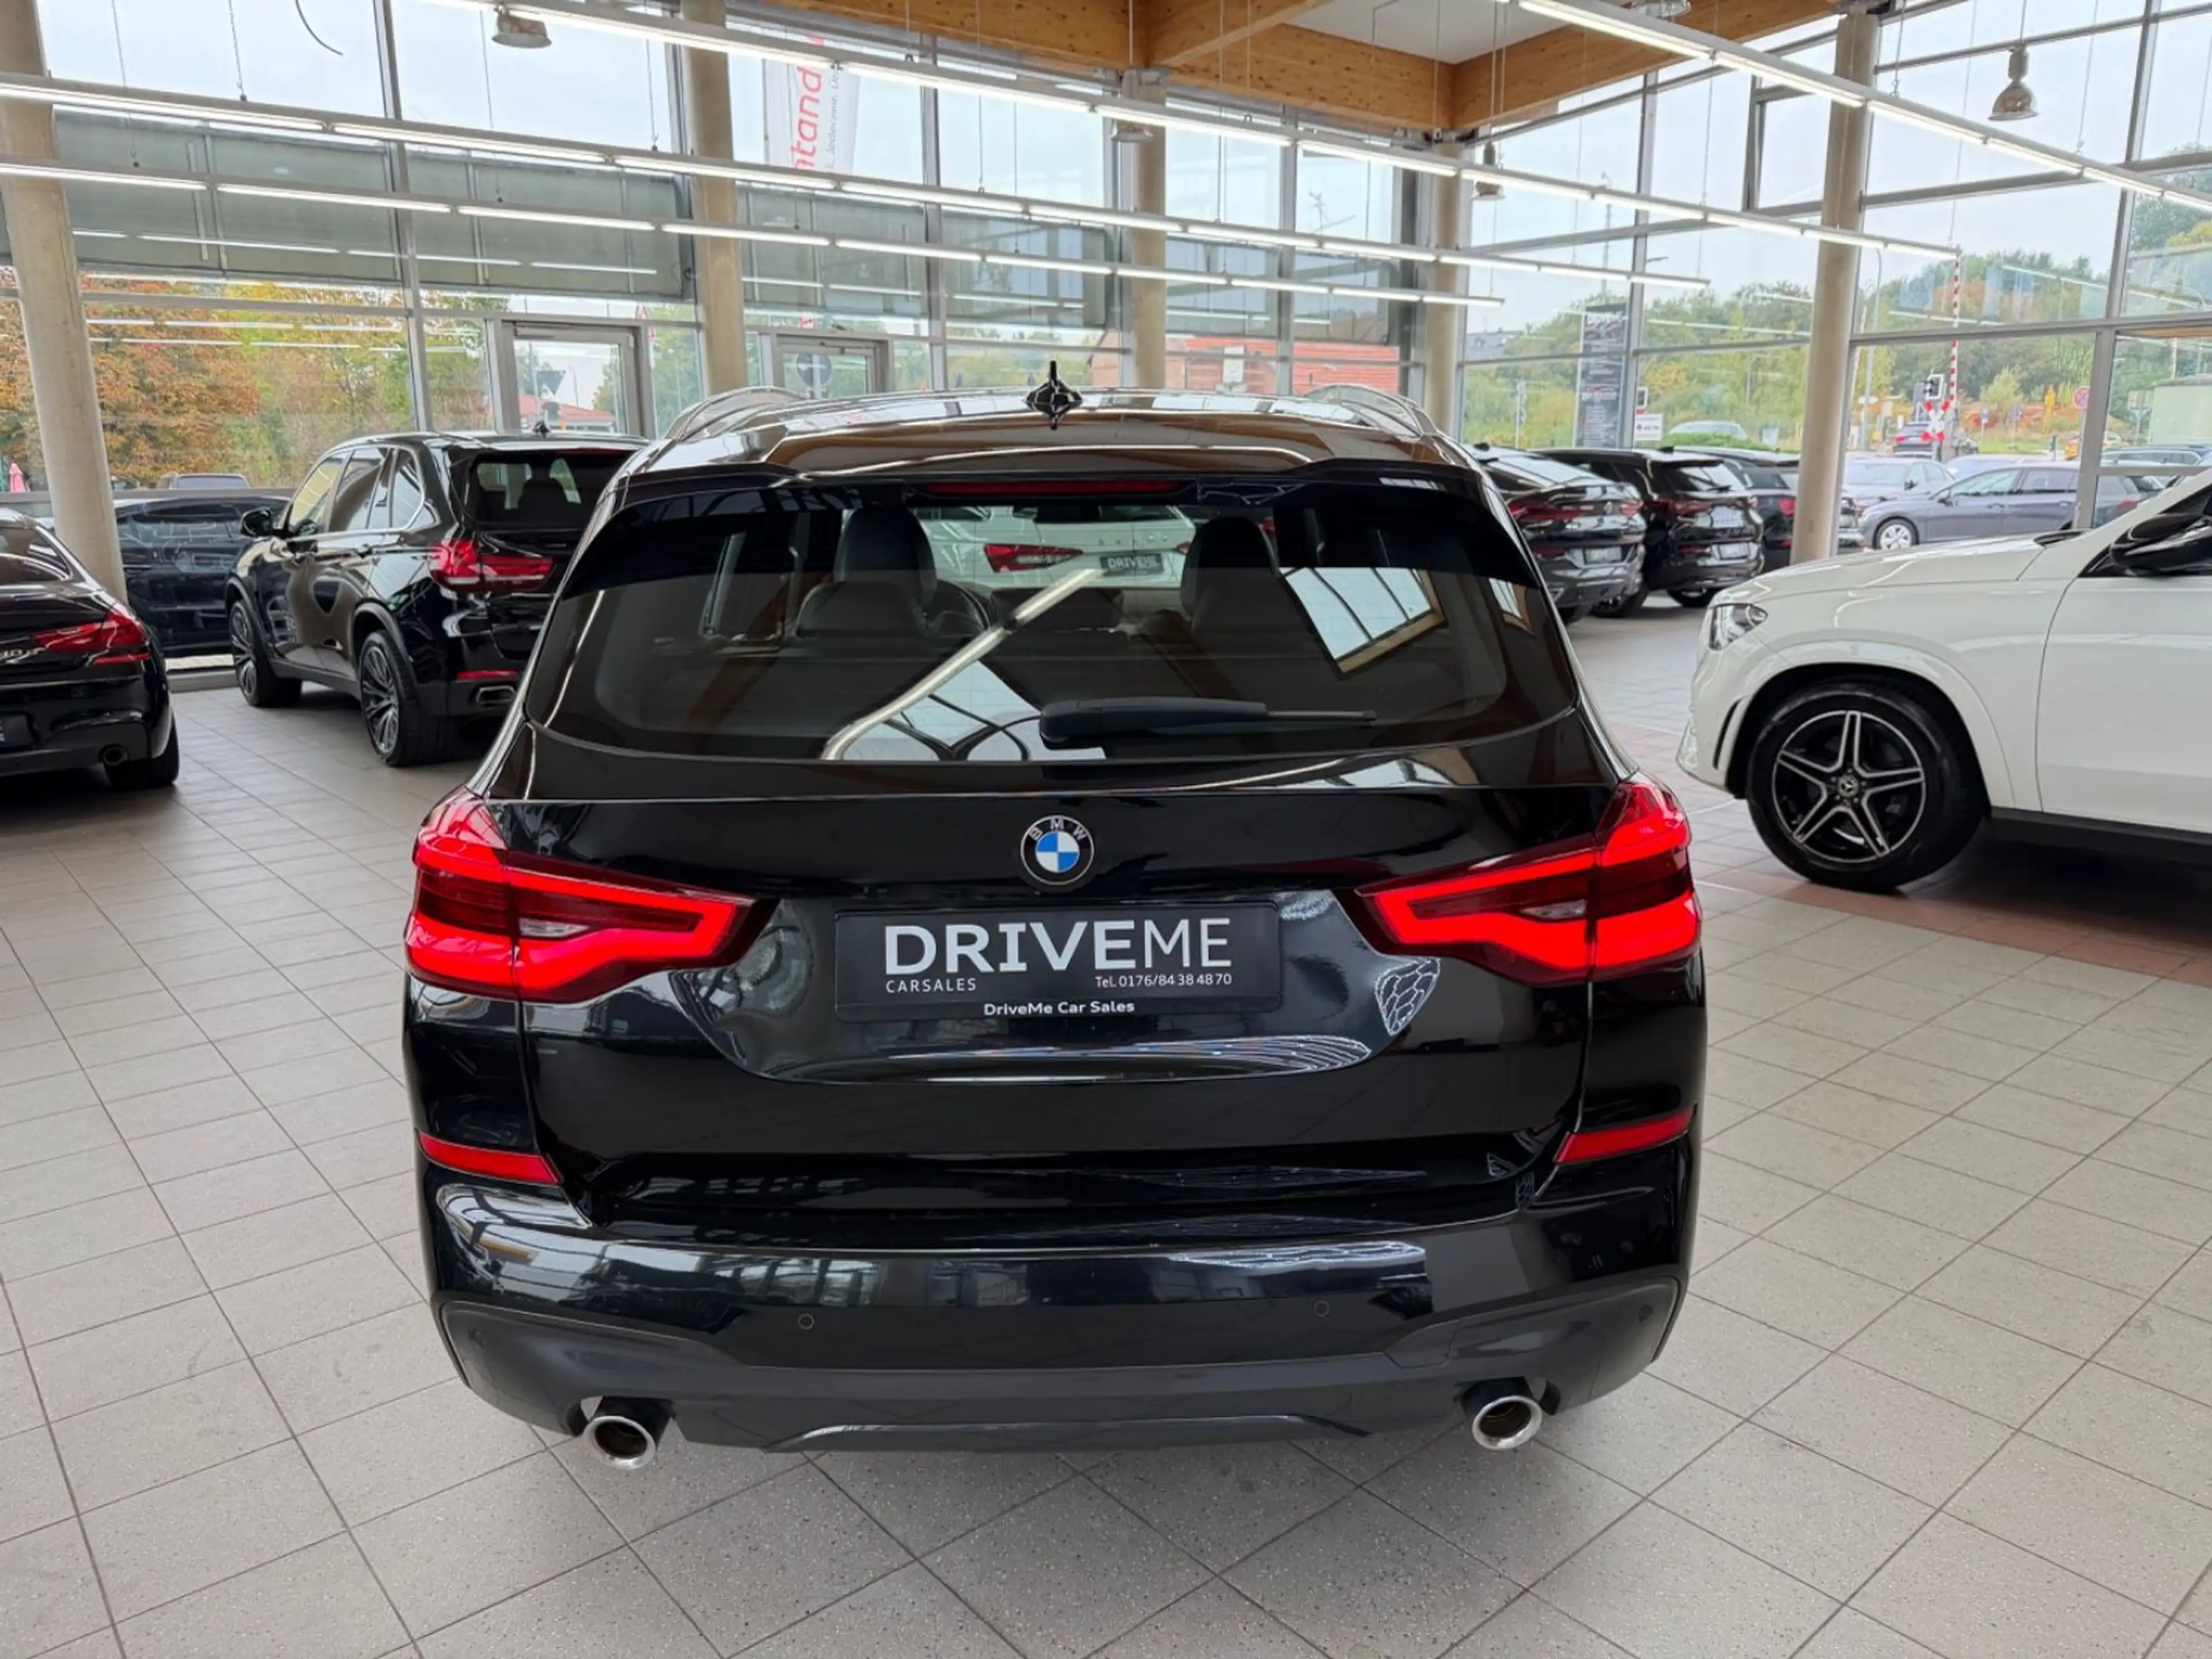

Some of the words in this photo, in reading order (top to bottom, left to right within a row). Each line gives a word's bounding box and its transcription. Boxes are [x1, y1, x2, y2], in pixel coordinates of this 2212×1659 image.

[1028, 818, 1087, 841] BMW
[885, 918, 1232, 975] DRIVEME
[885, 977, 977, 993] CARSALES
[983, 1002, 1053, 1016] DriveMe
[1058, 1001, 1086, 1014] Car
[1090, 1001, 1135, 1013] Sales
